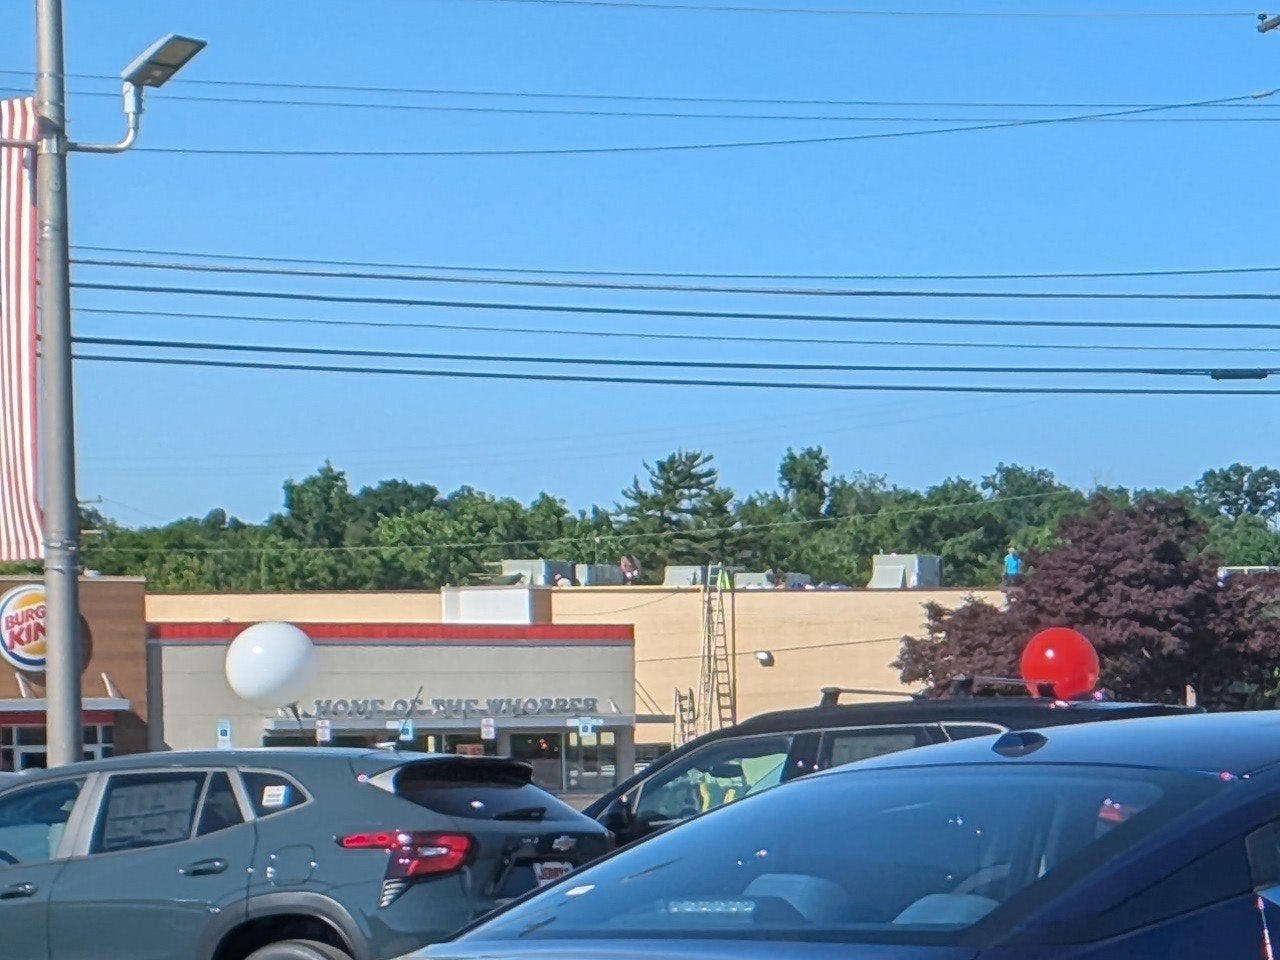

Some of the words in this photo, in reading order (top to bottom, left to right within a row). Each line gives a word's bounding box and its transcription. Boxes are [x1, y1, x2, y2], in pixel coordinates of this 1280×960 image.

[5, 604, 47, 630] BURG
[9, 621, 47, 650] KIN
[314, 698, 386, 716] HOME
[393, 698, 424, 715] OF
[431, 698, 480, 715] THE
[486, 697, 597, 714] WHOPPER
